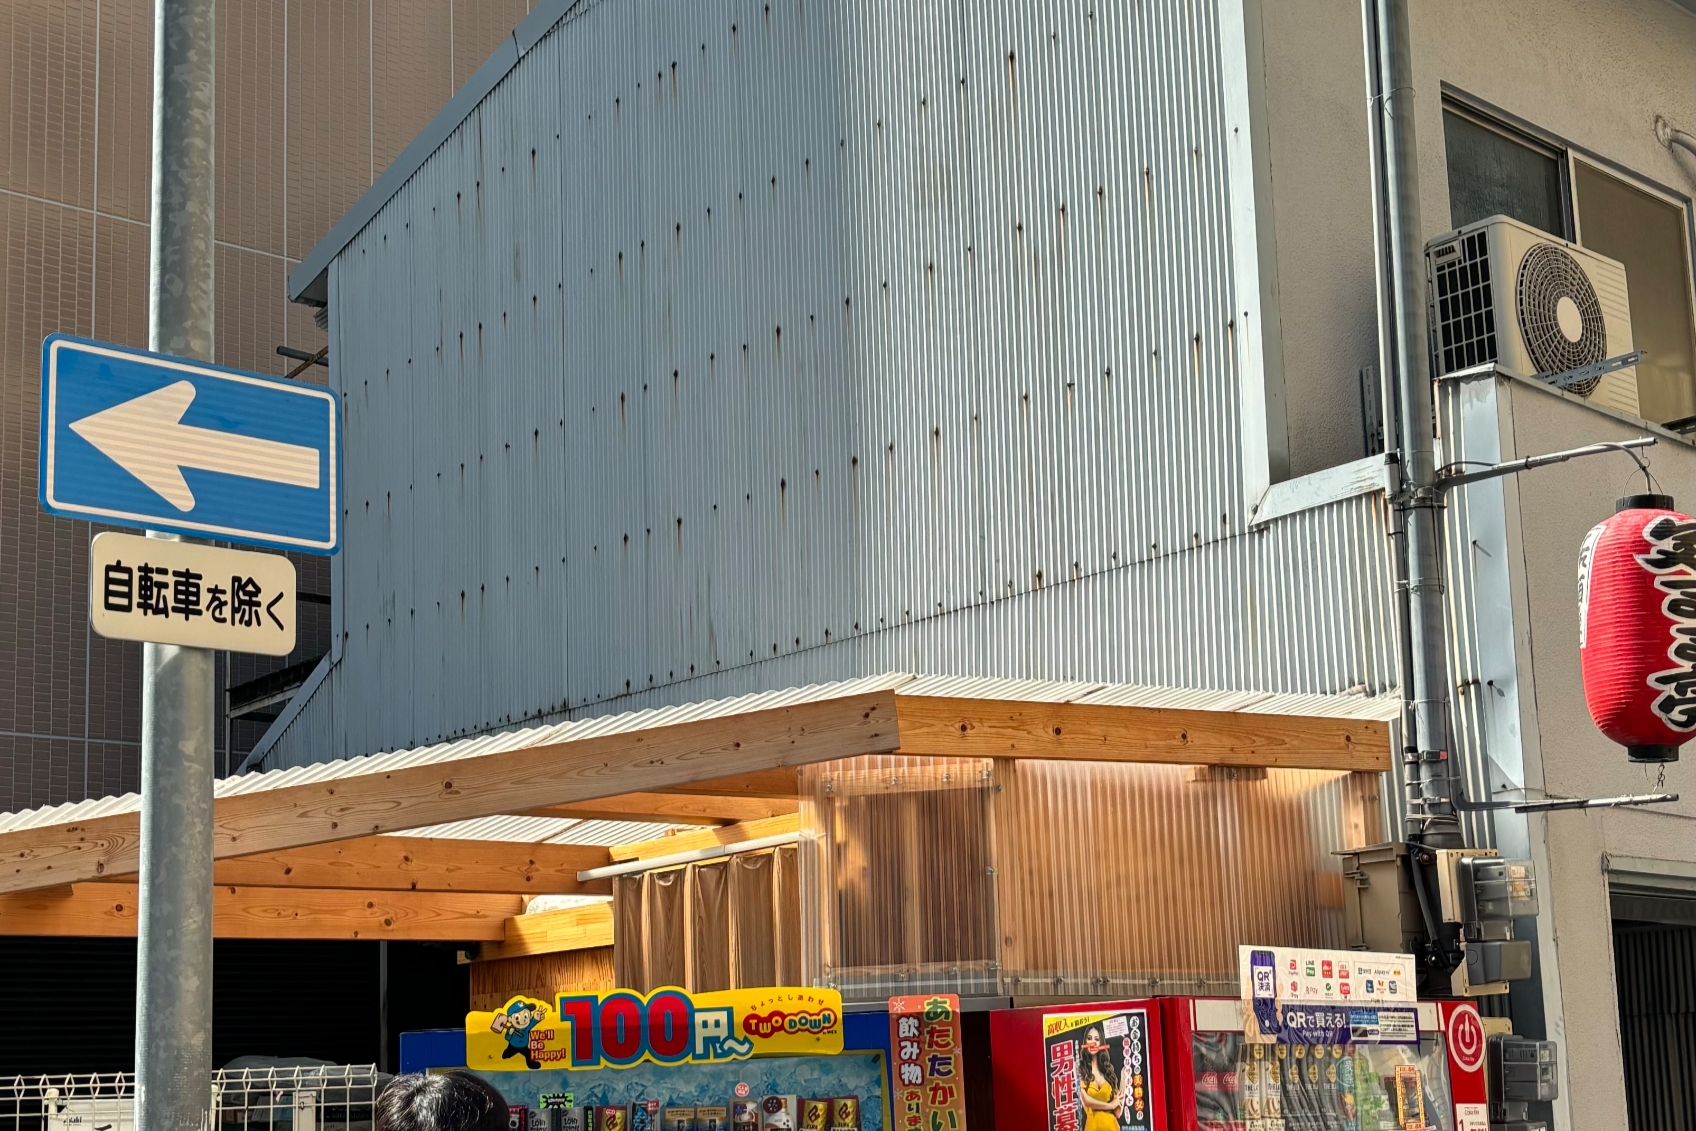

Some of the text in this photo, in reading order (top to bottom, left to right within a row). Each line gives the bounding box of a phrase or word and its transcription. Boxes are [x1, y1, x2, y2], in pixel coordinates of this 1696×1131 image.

[103, 559, 285, 632] 自転車を除く
[1257, 970, 1269, 982] QR
[1257, 982, 1271, 992] 決済
[750, 994, 825, 1011] ちょっとしあわせ
[749, 1013, 832, 1034] TWO DOWN
[1286, 1012, 1347, 1029] QRで買える!
[529, 1029, 555, 1041] We'll
[1302, 1030, 1312, 1038] Pay
[530, 1040, 544, 1050] Be
[530, 1048, 567, 1061] Happy!
